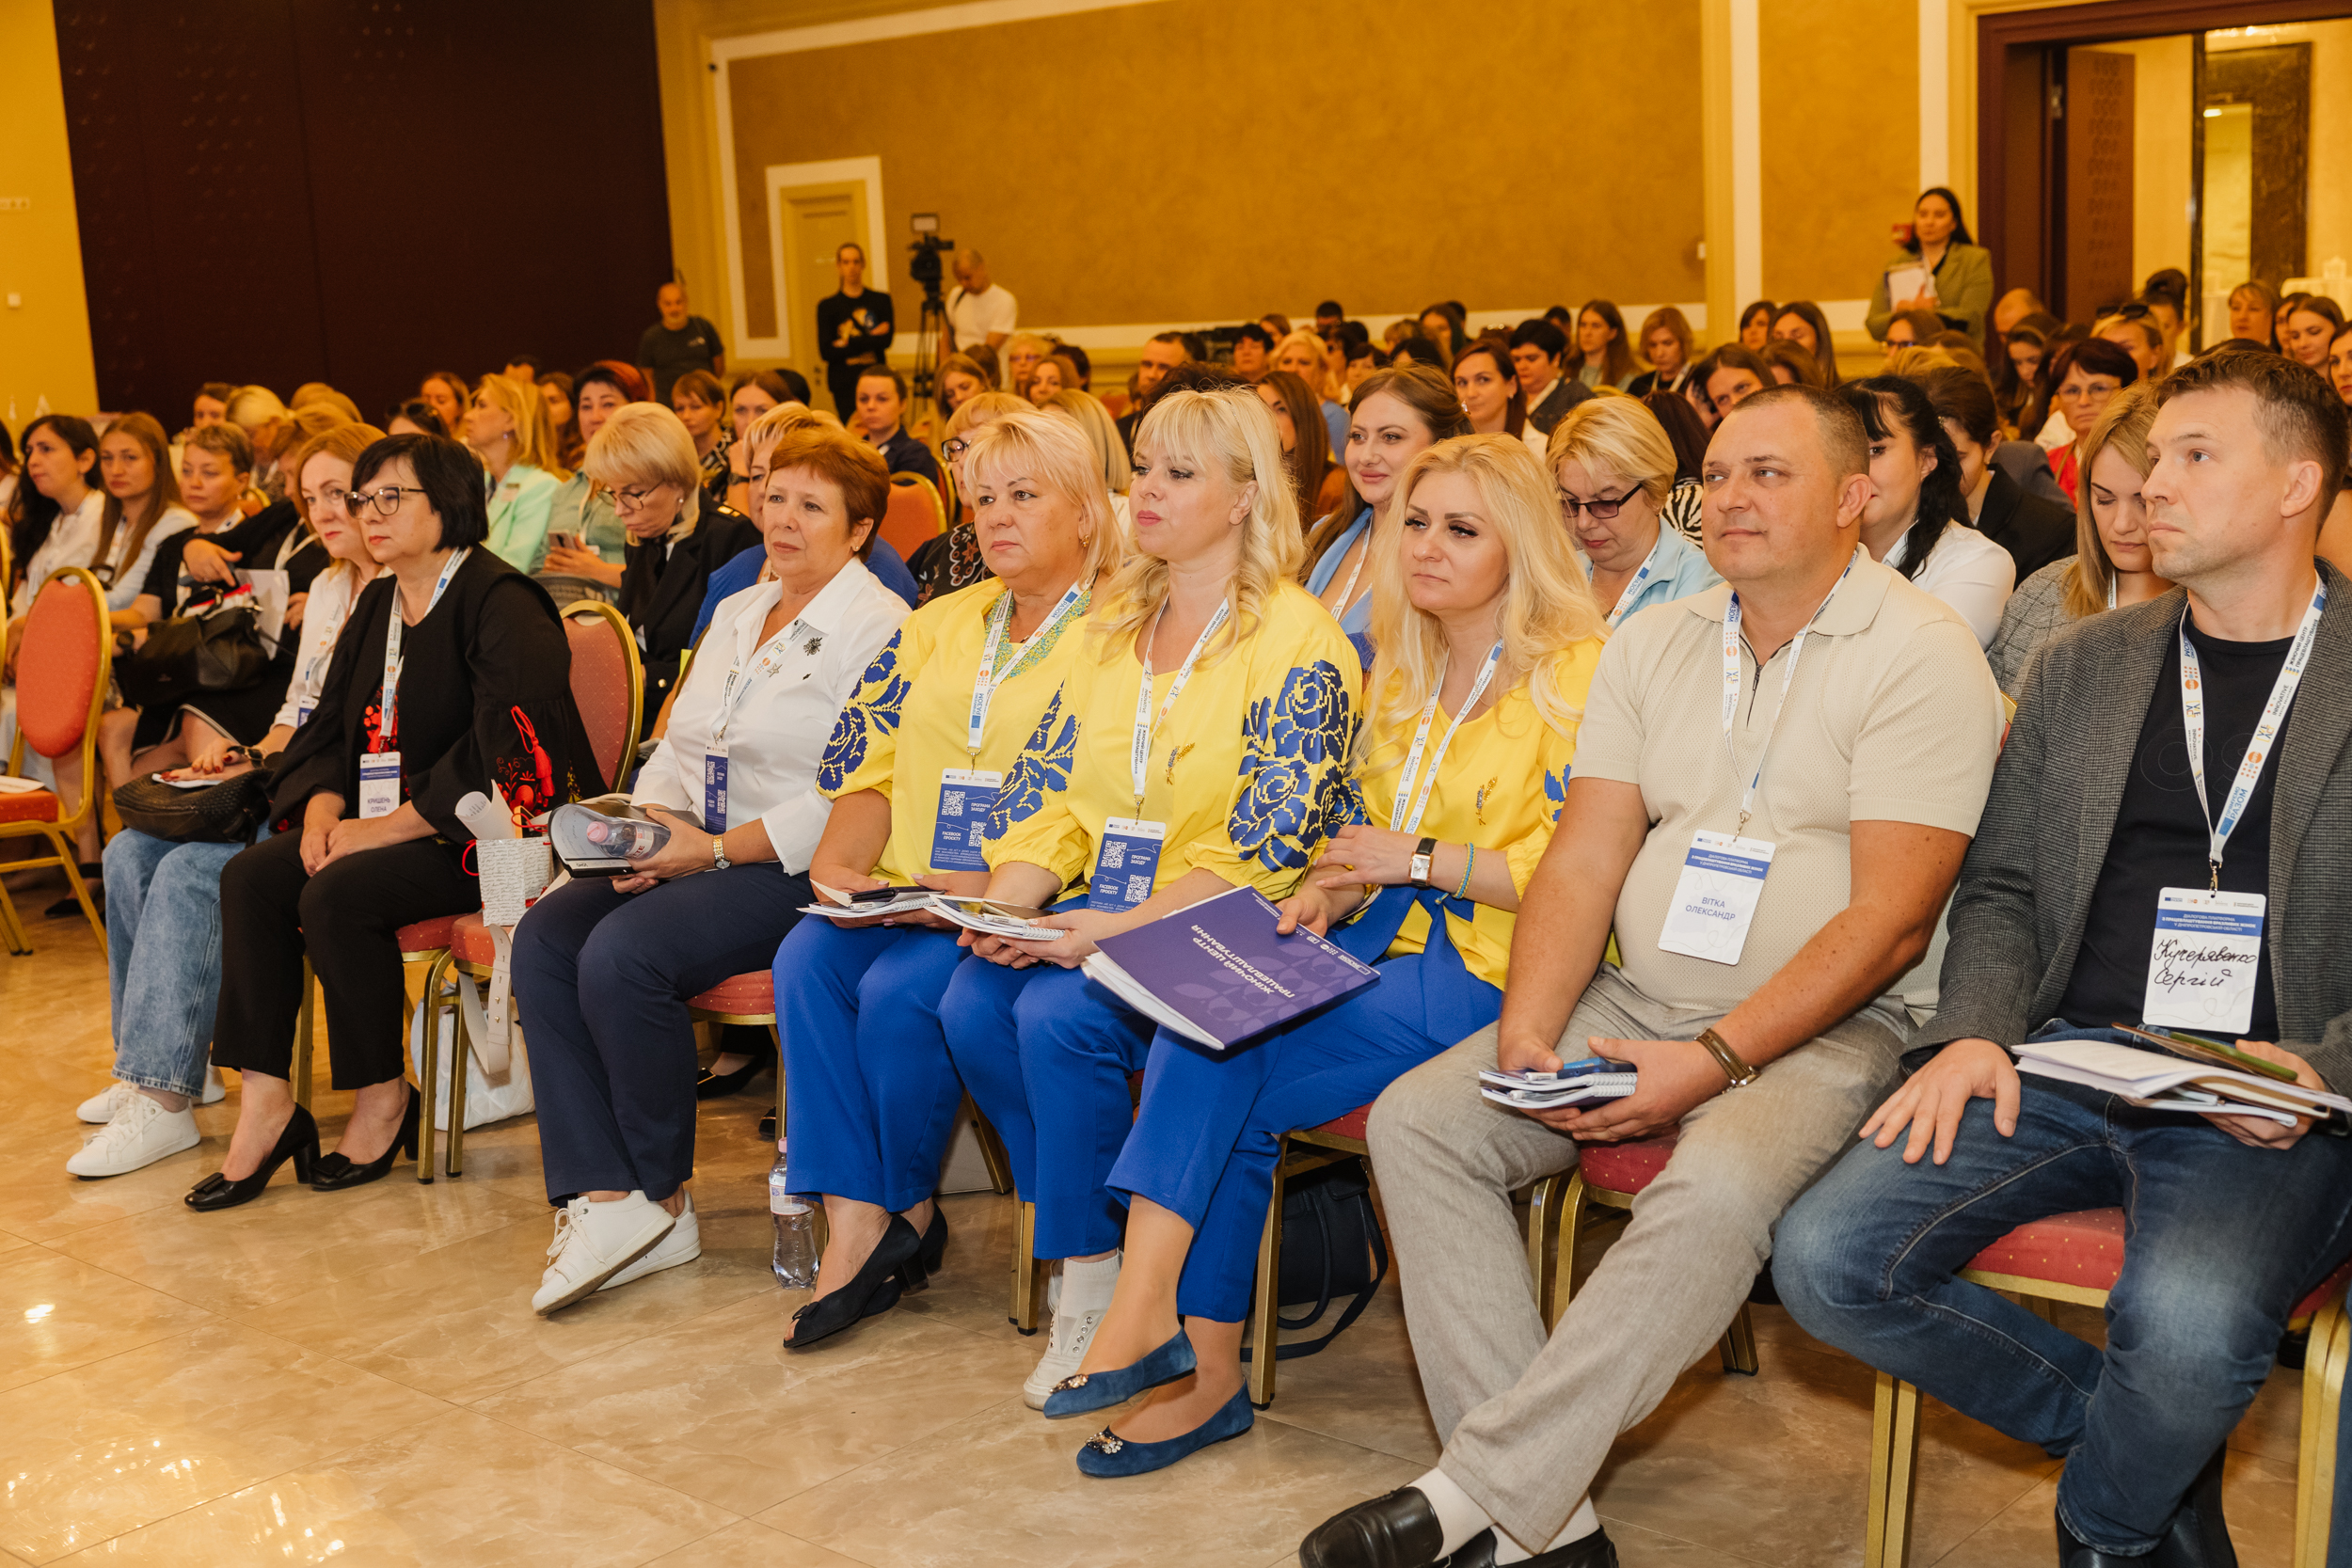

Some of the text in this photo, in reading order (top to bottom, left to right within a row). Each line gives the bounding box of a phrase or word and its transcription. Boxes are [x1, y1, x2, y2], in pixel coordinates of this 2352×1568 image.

[1627, 576, 1641, 595] РАЗОМ
[1051, 600, 1068, 618] РАЗОМ
[2288, 626, 2310, 666] ЖІНОЧИЙ ЦЕНТР
[2296, 619, 2318, 668] ПРАЦЕВЛАШТУВАННЯ
[976, 692, 985, 715] РАЗОМ
[2271, 684, 2289, 716] INNOVATIVE
[2191, 728, 2200, 760] INNOVATIVE
[2225, 786, 2240, 816] ПРЯМУЄМО
[2230, 788, 2249, 819] РАЗОМ
[1685, 905, 1736, 921] ОЛЕКСАНДР
[1702, 897, 1725, 908] ВІТКА
[1190, 924, 1295, 998] ПРАЦЕВЛАШТУВАННЯ
[1192, 936, 1275, 993] ЖІНОЧИЙ ЦЕНТР
[2154, 968, 2233, 993] Сергій
